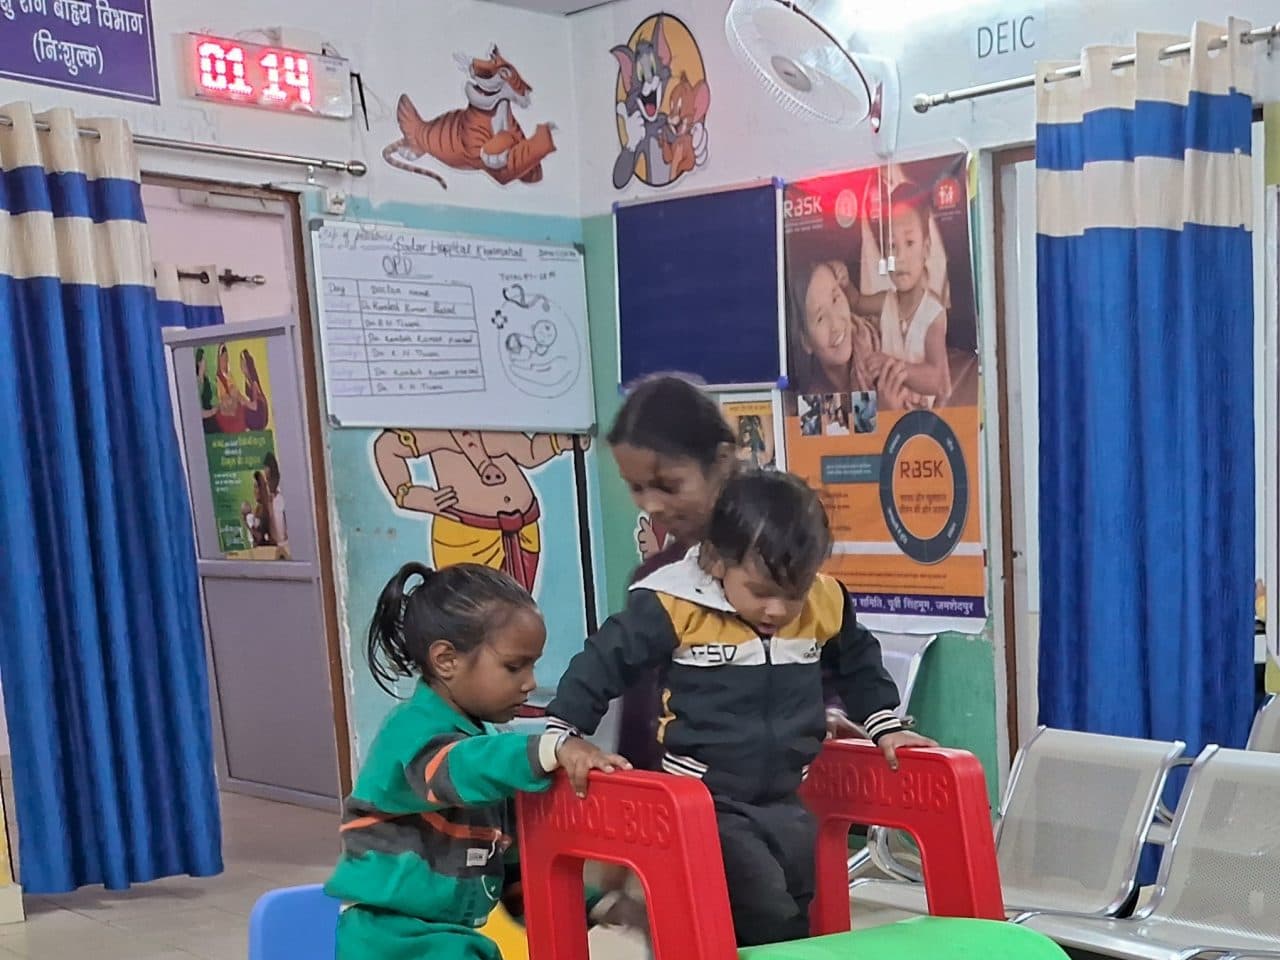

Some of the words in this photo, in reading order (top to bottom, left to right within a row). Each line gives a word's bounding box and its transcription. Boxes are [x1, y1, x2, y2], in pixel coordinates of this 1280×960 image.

[96, 0, 144, 35] विभाग
[977, 15, 1035, 58] DEIC
[900, 460, 944, 478] RBSK
[902, 769, 949, 813] BUS
[621, 799, 671, 849] BUS
